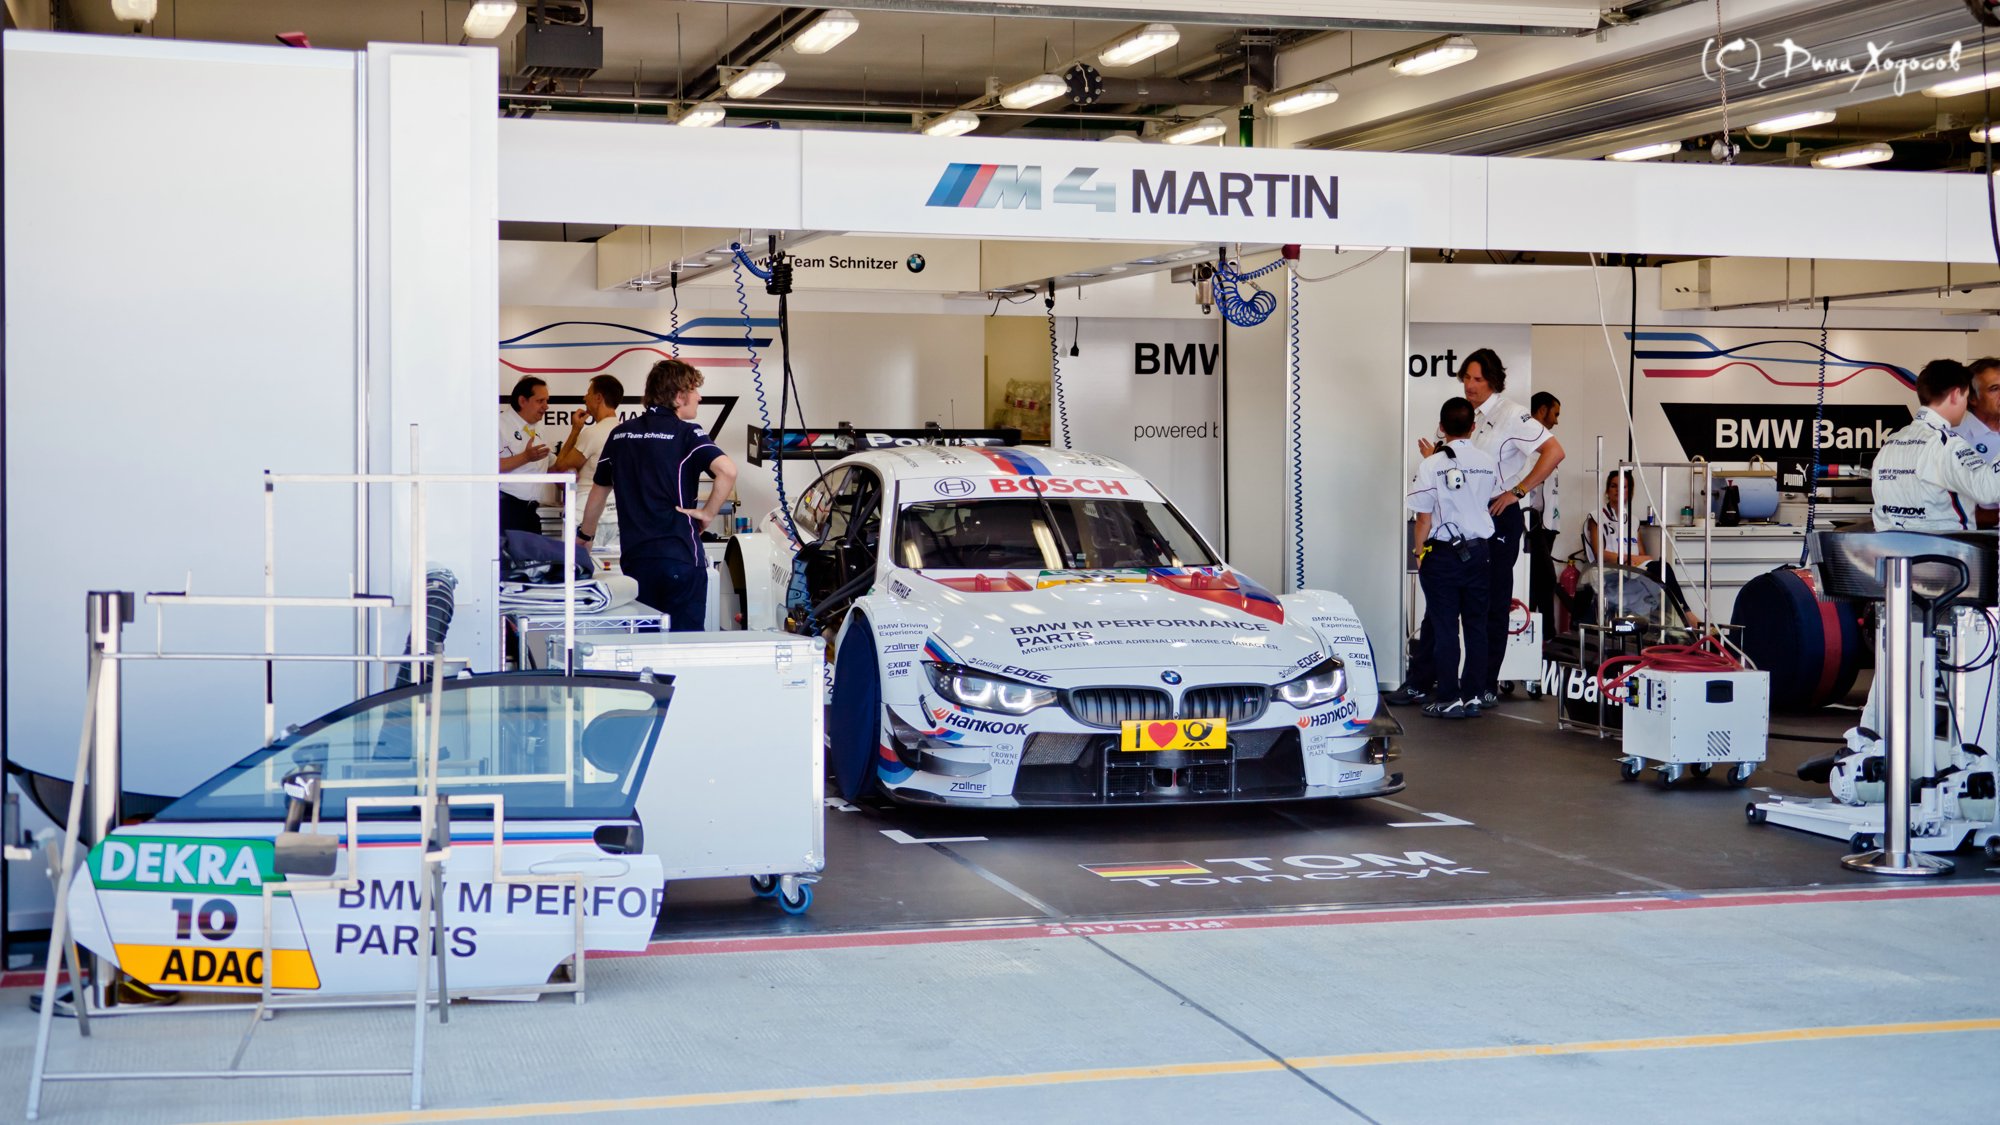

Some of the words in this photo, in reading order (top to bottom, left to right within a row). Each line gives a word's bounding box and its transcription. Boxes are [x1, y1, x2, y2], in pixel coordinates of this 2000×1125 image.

[1053, 167, 1116, 212] 4
[1131, 168, 1339, 220] MARTIN
[787, 255, 825, 268] Team
[829, 255, 898, 270] Schnitzer
[1134, 421, 1207, 441] powered
[1715, 418, 1803, 449] BMW
[1812, 419, 1893, 450] Bank
[988, 478, 1130, 496] BOSCH
[900, 622, 929, 630] Driving
[1010, 622, 1067, 635] BMW
[1072, 621, 1093, 629] M
[1097, 619, 1271, 632] PERFORMANCE
[884, 643, 920, 654] Zollner
[1016, 631, 1094, 648] PARTS
[1021, 645, 1052, 655] MORE
[1297, 651, 1324, 668] EDGE
[886, 661, 912, 669] EXIDE
[976, 659, 1002, 670] Castrol
[1002, 665, 1053, 683] EDGE
[1135, 723, 1141, 748] I
[950, 782, 987, 793] Zollner
[100, 841, 263, 887] DEKRA
[1204, 850, 1458, 872] TOM
[1110, 866, 1491, 888] Tomczyk
[458, 882, 493, 913] M
[171, 898, 238, 941] 10
[334, 923, 477, 957] PARTS
